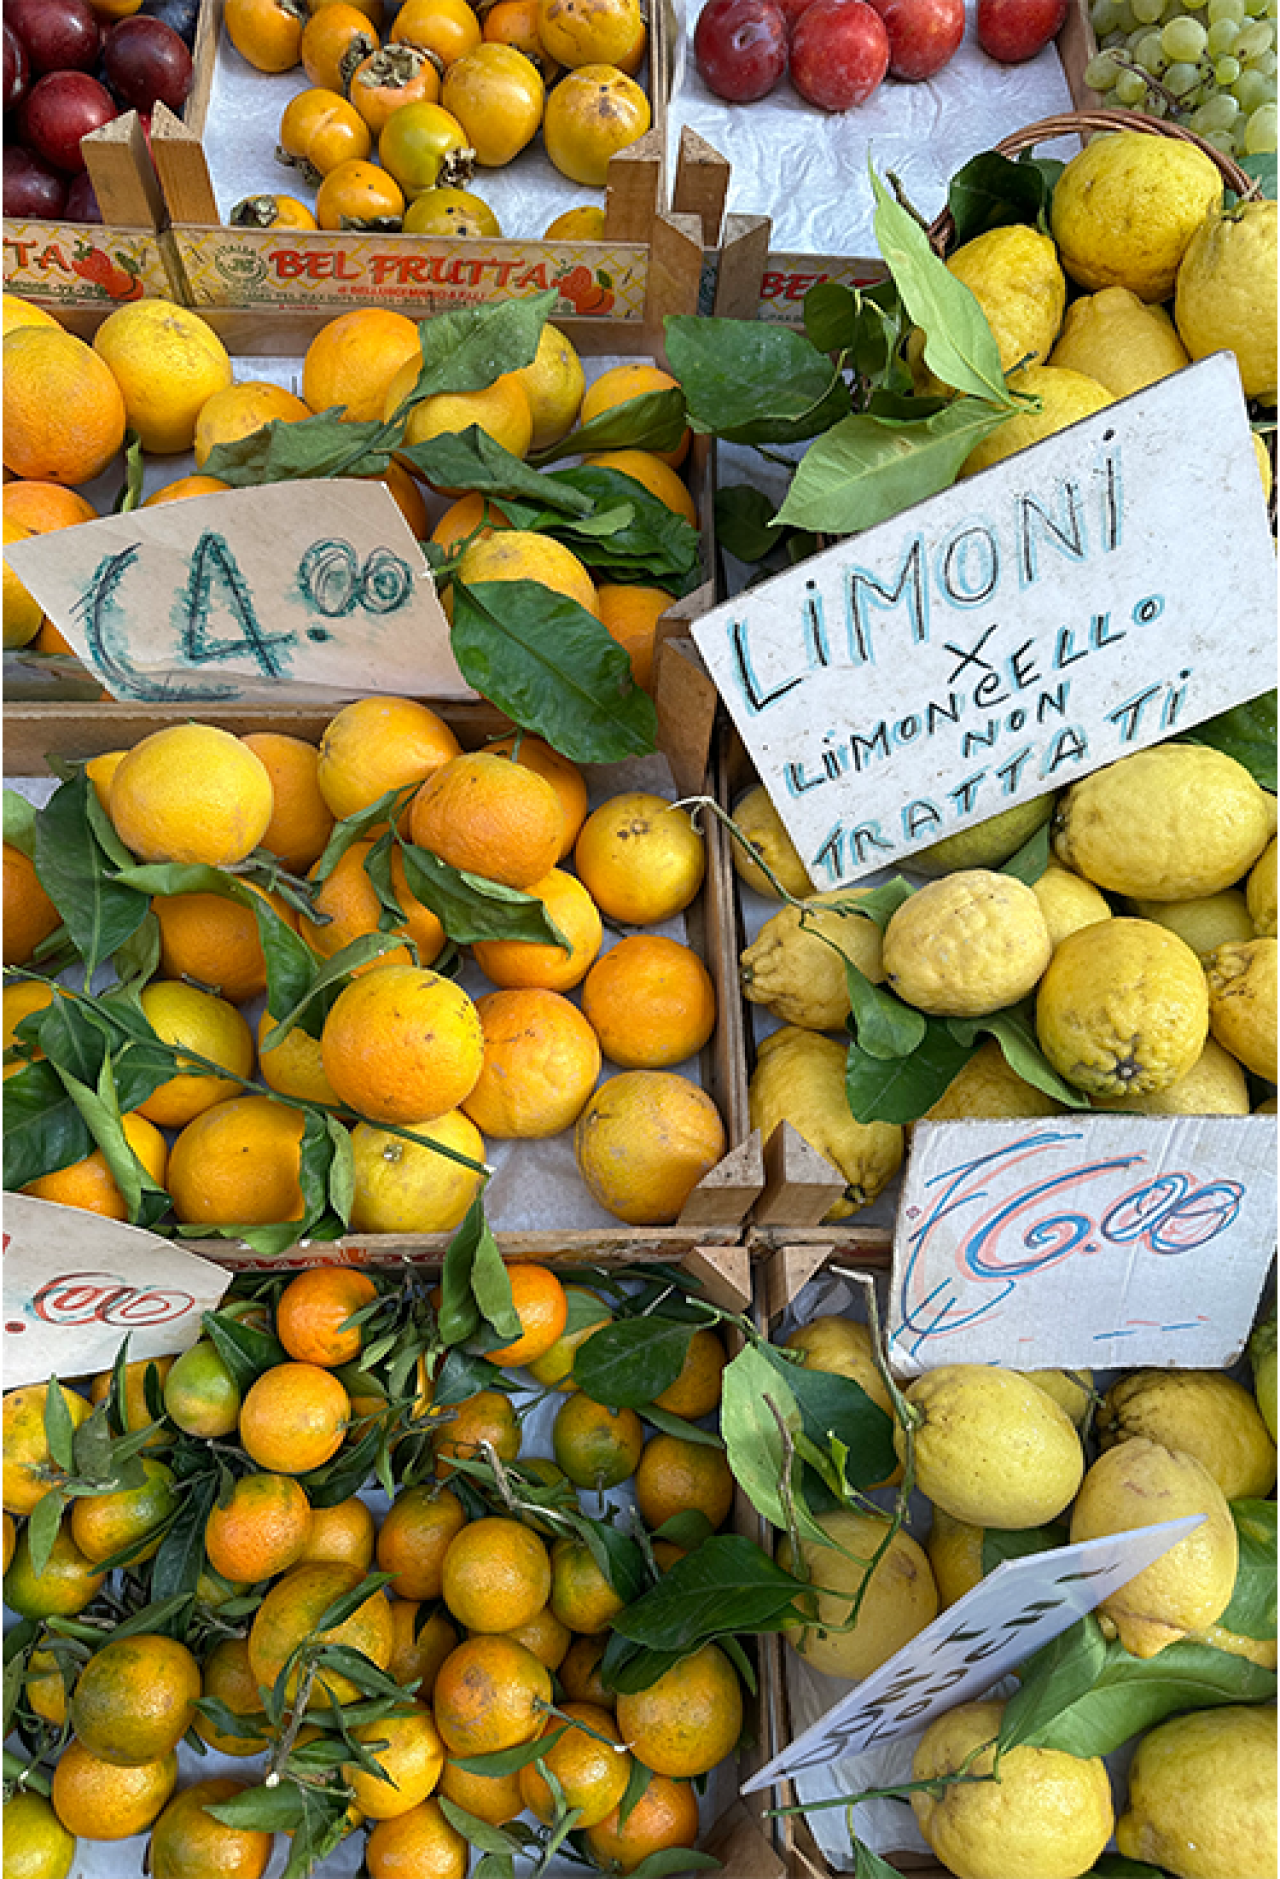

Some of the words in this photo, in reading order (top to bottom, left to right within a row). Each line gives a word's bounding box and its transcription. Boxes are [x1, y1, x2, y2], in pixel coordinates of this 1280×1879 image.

[268, 250, 363, 279] BEL
[369, 255, 549, 290] FRUTTA
[727, 428, 1124, 716] LiMONi
[962, 682, 1072, 758] NON
[3, 1231, 196, 1335] .00
[773, 1620, 989, 1777] DON'T
[862, 1561, 1121, 1750] TOUCH!
